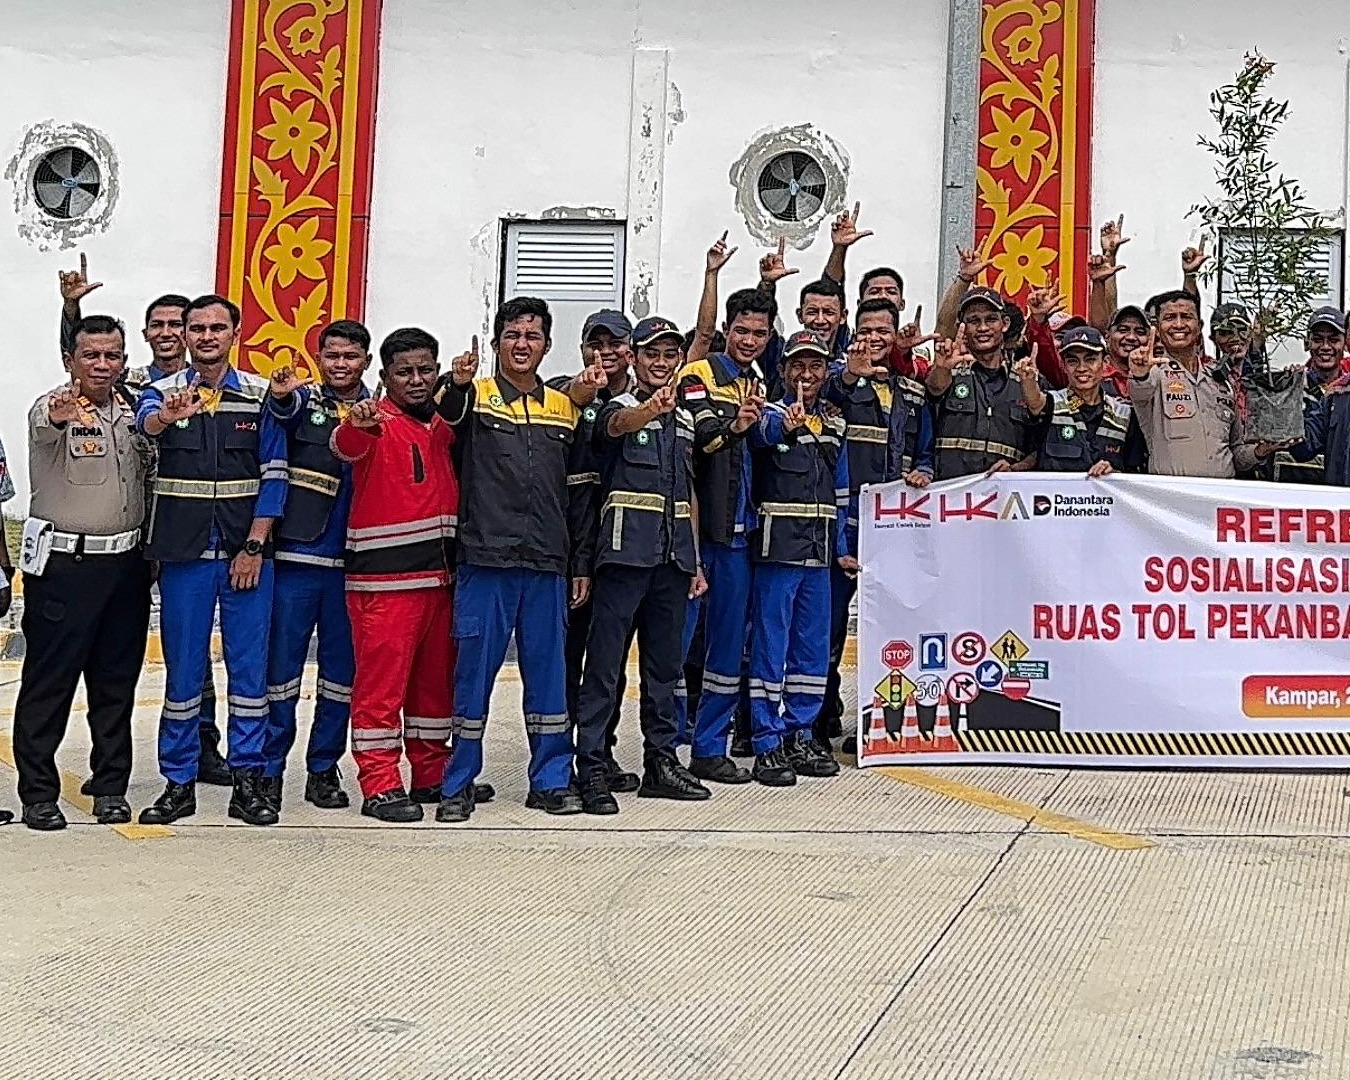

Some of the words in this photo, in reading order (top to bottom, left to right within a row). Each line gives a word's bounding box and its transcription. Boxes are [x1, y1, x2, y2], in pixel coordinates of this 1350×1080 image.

[1054, 494, 1114, 506] Danantara
[1054, 506, 1110, 517] Indonesia
[1145, 557, 1350, 593] SOSIALISASI
[1033, 604, 1121, 641] RUAS
[1132, 604, 1196, 640] TOL
[885, 649, 911, 662] STOP
[1265, 686, 1341, 709] Kampar,
